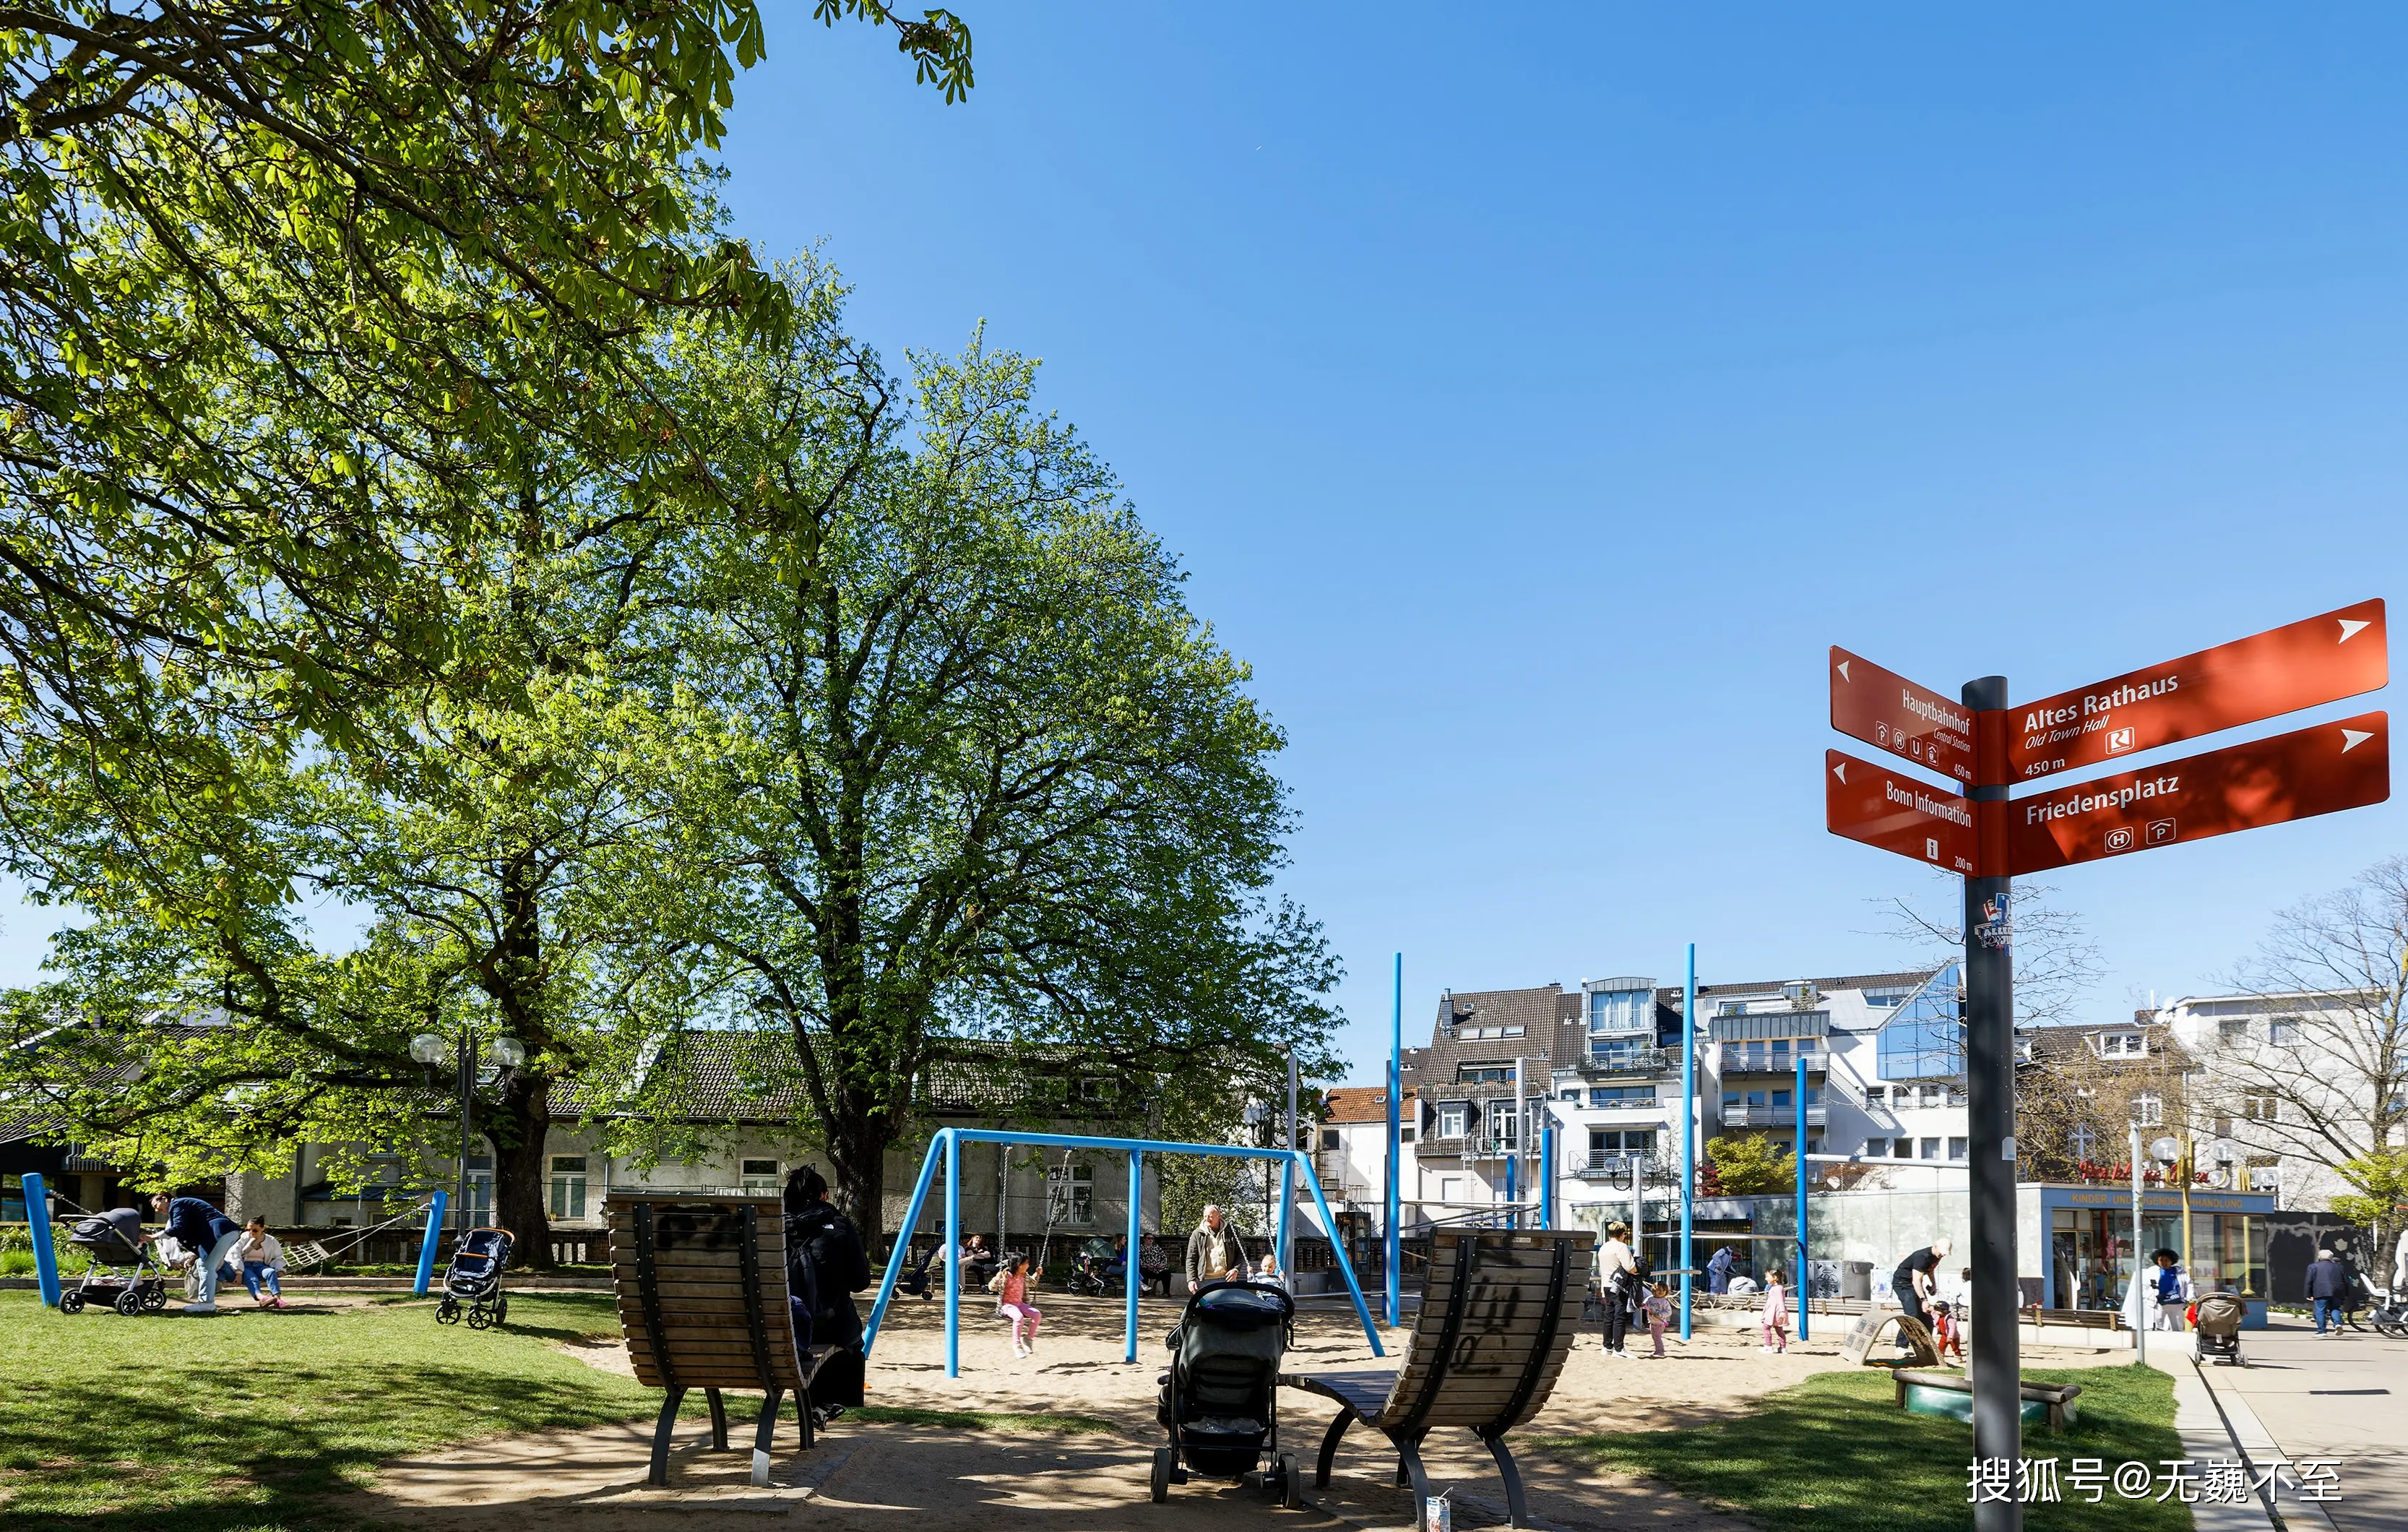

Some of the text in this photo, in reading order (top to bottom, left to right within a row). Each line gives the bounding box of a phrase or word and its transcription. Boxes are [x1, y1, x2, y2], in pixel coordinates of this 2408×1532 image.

[1902, 688, 1970, 736] Hauptbahnhof
[2024, 675, 2178, 733] Altes Rathaus
[1933, 727, 1971, 753] Central Station
[2025, 714, 2110, 749] Old Town Hall
[1954, 763, 1972, 780] 450 m
[2025, 758, 2066, 776] 450 m
[1886, 780, 1972, 828] Bonn Information
[2027, 776, 2180, 825] Friedensplatz
[1954, 856, 1972, 872] 200 m
[2111, 1161, 2162, 1182] klne
[2071, 1192, 2243, 1209] KINDER- UND GENDBUHHANDLUNG
